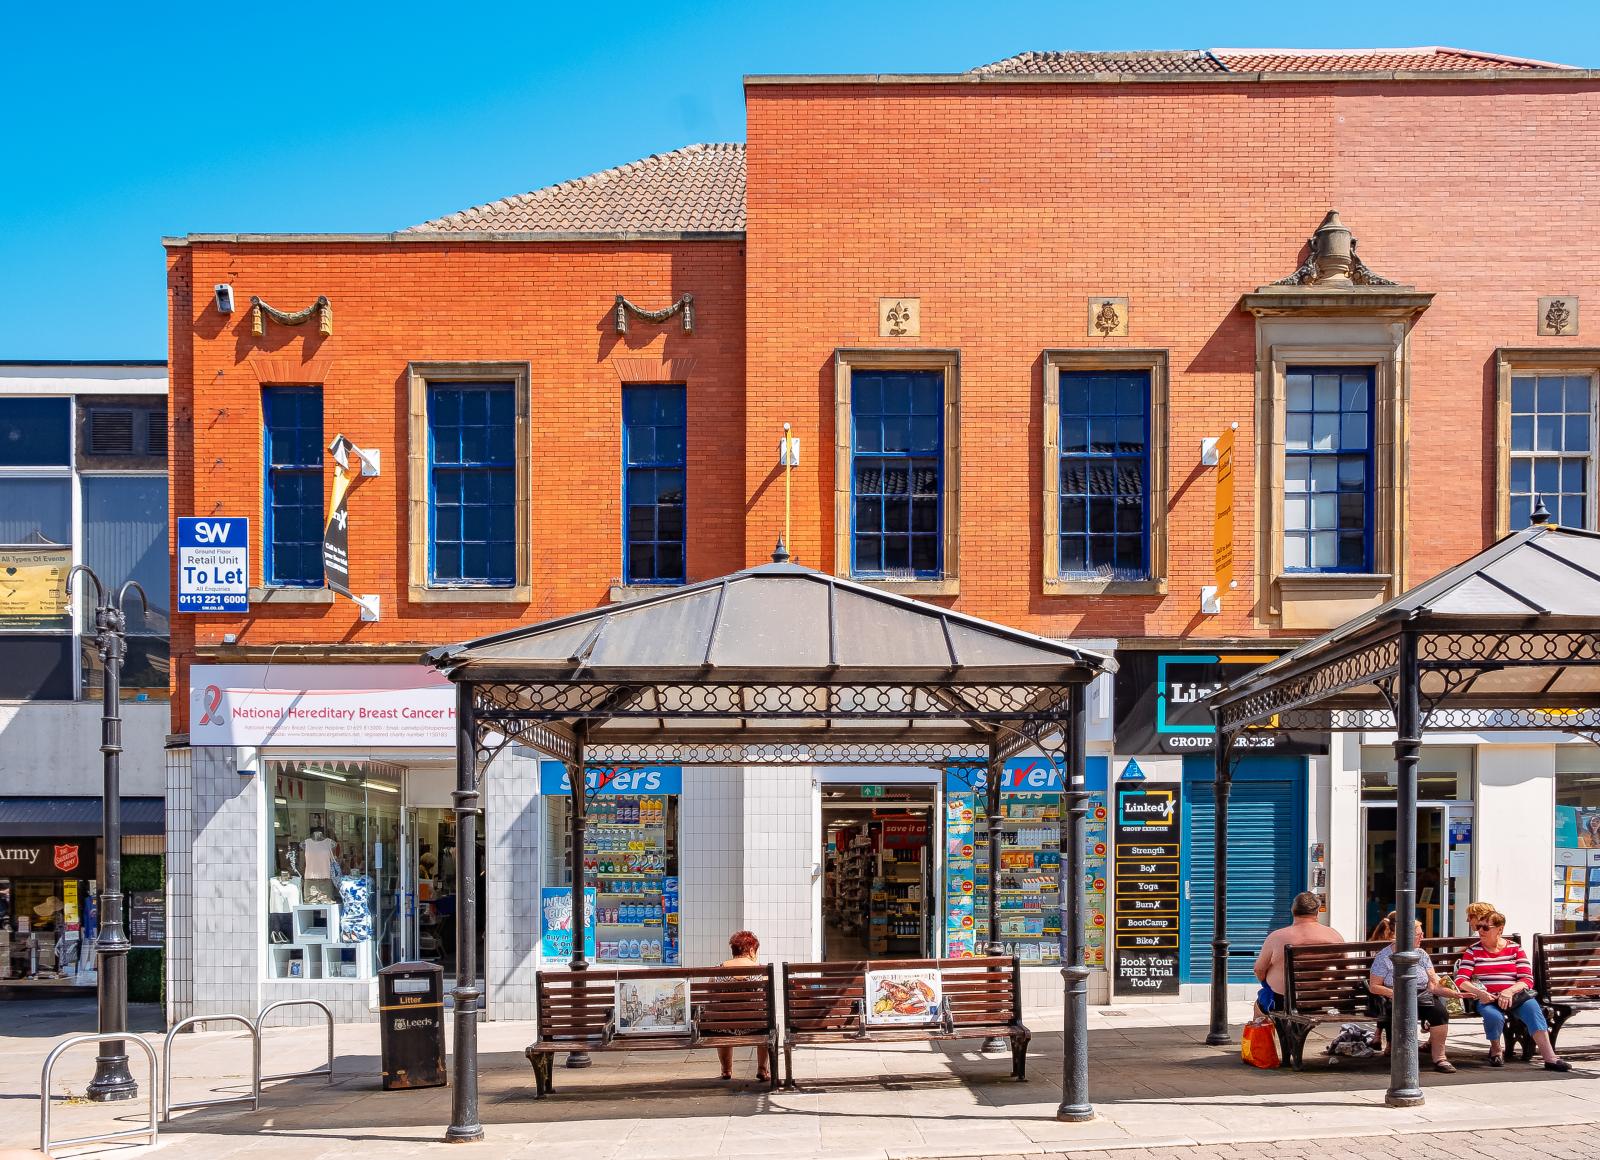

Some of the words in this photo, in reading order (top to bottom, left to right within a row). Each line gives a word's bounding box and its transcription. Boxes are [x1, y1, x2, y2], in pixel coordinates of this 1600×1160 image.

[195, 522, 231, 543] SW
[187, 555, 216, 565] Retail
[218, 555, 239, 565] Unit
[183, 566, 208, 584] To
[214, 566, 243, 585] Let
[179, 595, 203, 604] 0113
[204, 595, 221, 604] 221
[223, 595, 247, 604] 6000
[232, 707, 284, 719] National
[288, 707, 354, 722] Hereditary
[359, 707, 397, 719] Breast
[401, 707, 443, 719] Cancer
[1169, 737, 1213, 747] GROUP
[1214, 737, 1275, 747] ERCISE
[974, 762, 1067, 787] saver
[1125, 800, 1176, 817] LinkedX
[1131, 847, 1165, 856] Strength
[1140, 865, 1157, 873] BoX
[1138, 883, 1159, 891] Yoga
[1127, 919, 1169, 928] BootCamp
[1136, 937, 1160, 945] BikeX
[1120, 957, 1147, 966] Book
[1149, 957, 1173, 967] Your
[1120, 968, 1147, 977] FREE
[1149, 968, 1173, 977] Trial
[1130, 978, 1163, 988] Today
[399, 996, 422, 1004] Litter
[406, 1017, 432, 1027] Leeds
